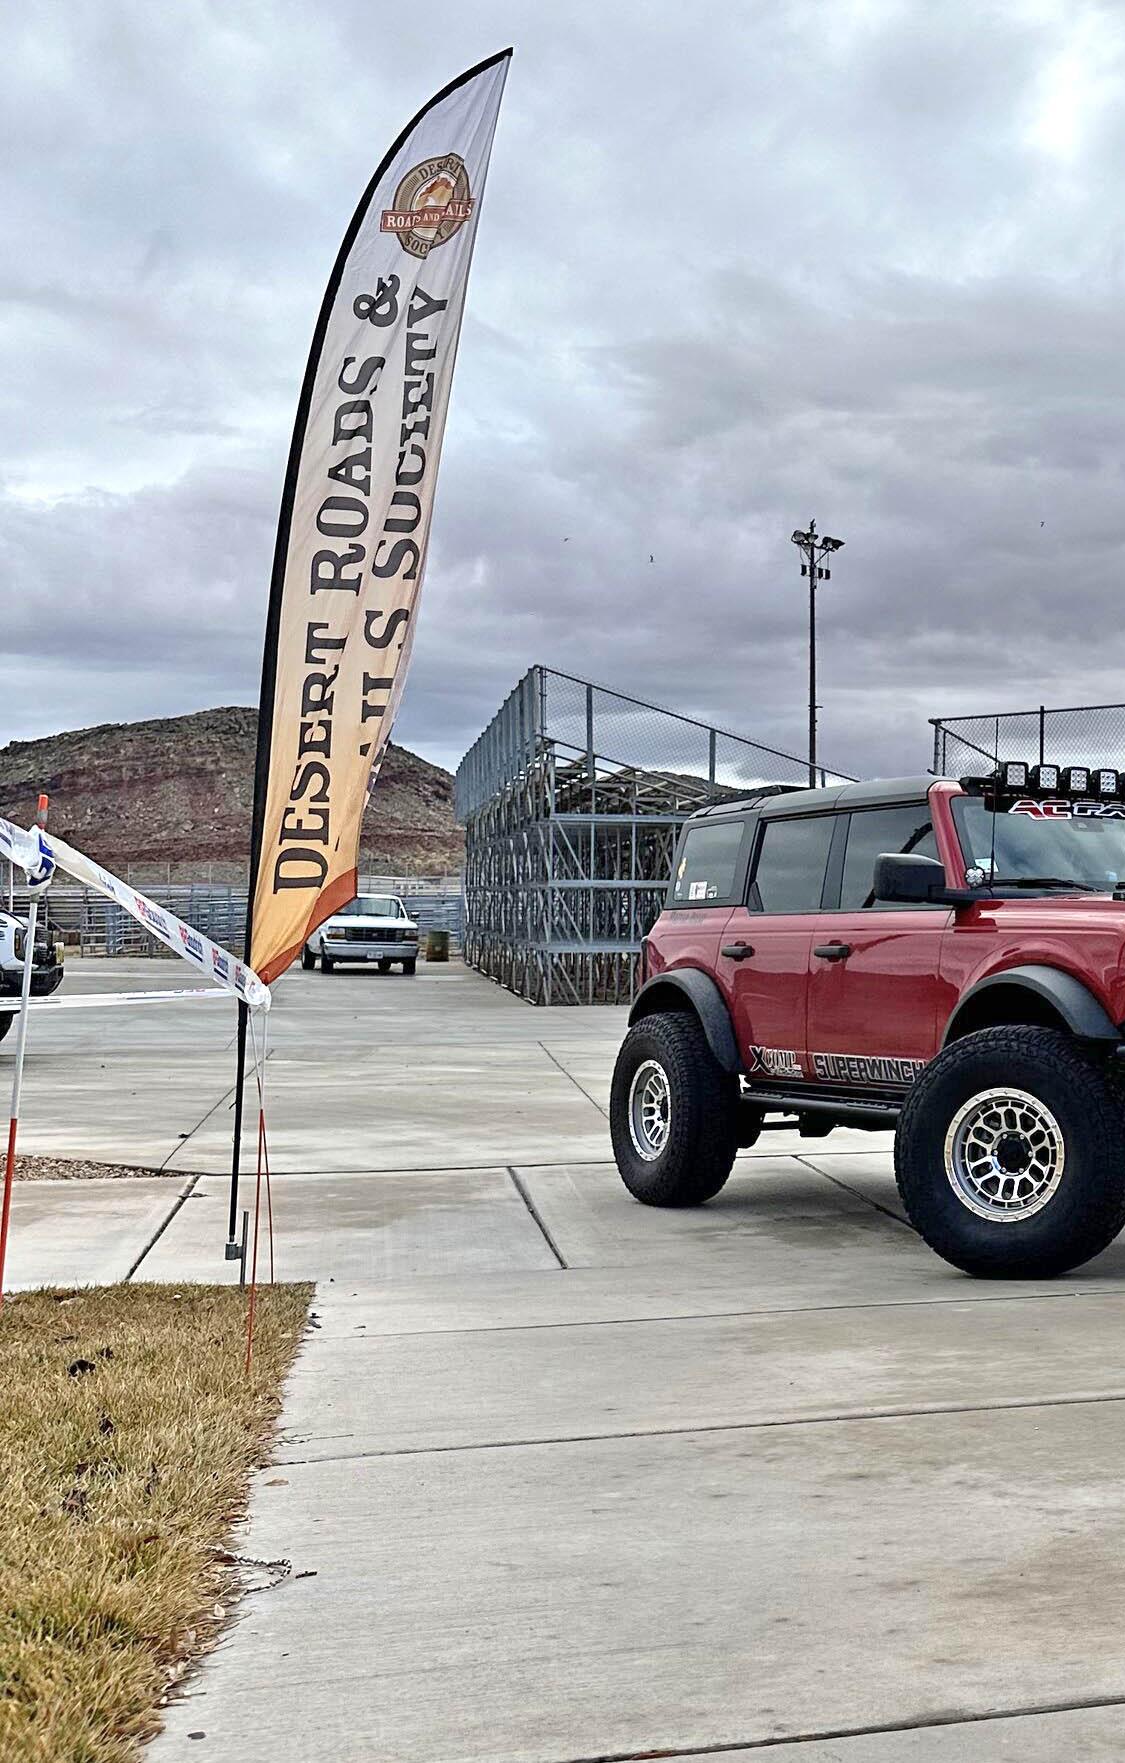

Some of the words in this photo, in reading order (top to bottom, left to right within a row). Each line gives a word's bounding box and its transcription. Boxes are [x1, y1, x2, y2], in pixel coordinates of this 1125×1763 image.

[422, 213, 440, 222] AND
[353, 273, 401, 329] &
[310, 356, 386, 597] ROADS
[273, 621, 348, 895] DESERT
[813, 1052, 927, 1084] SUPERWINCH
